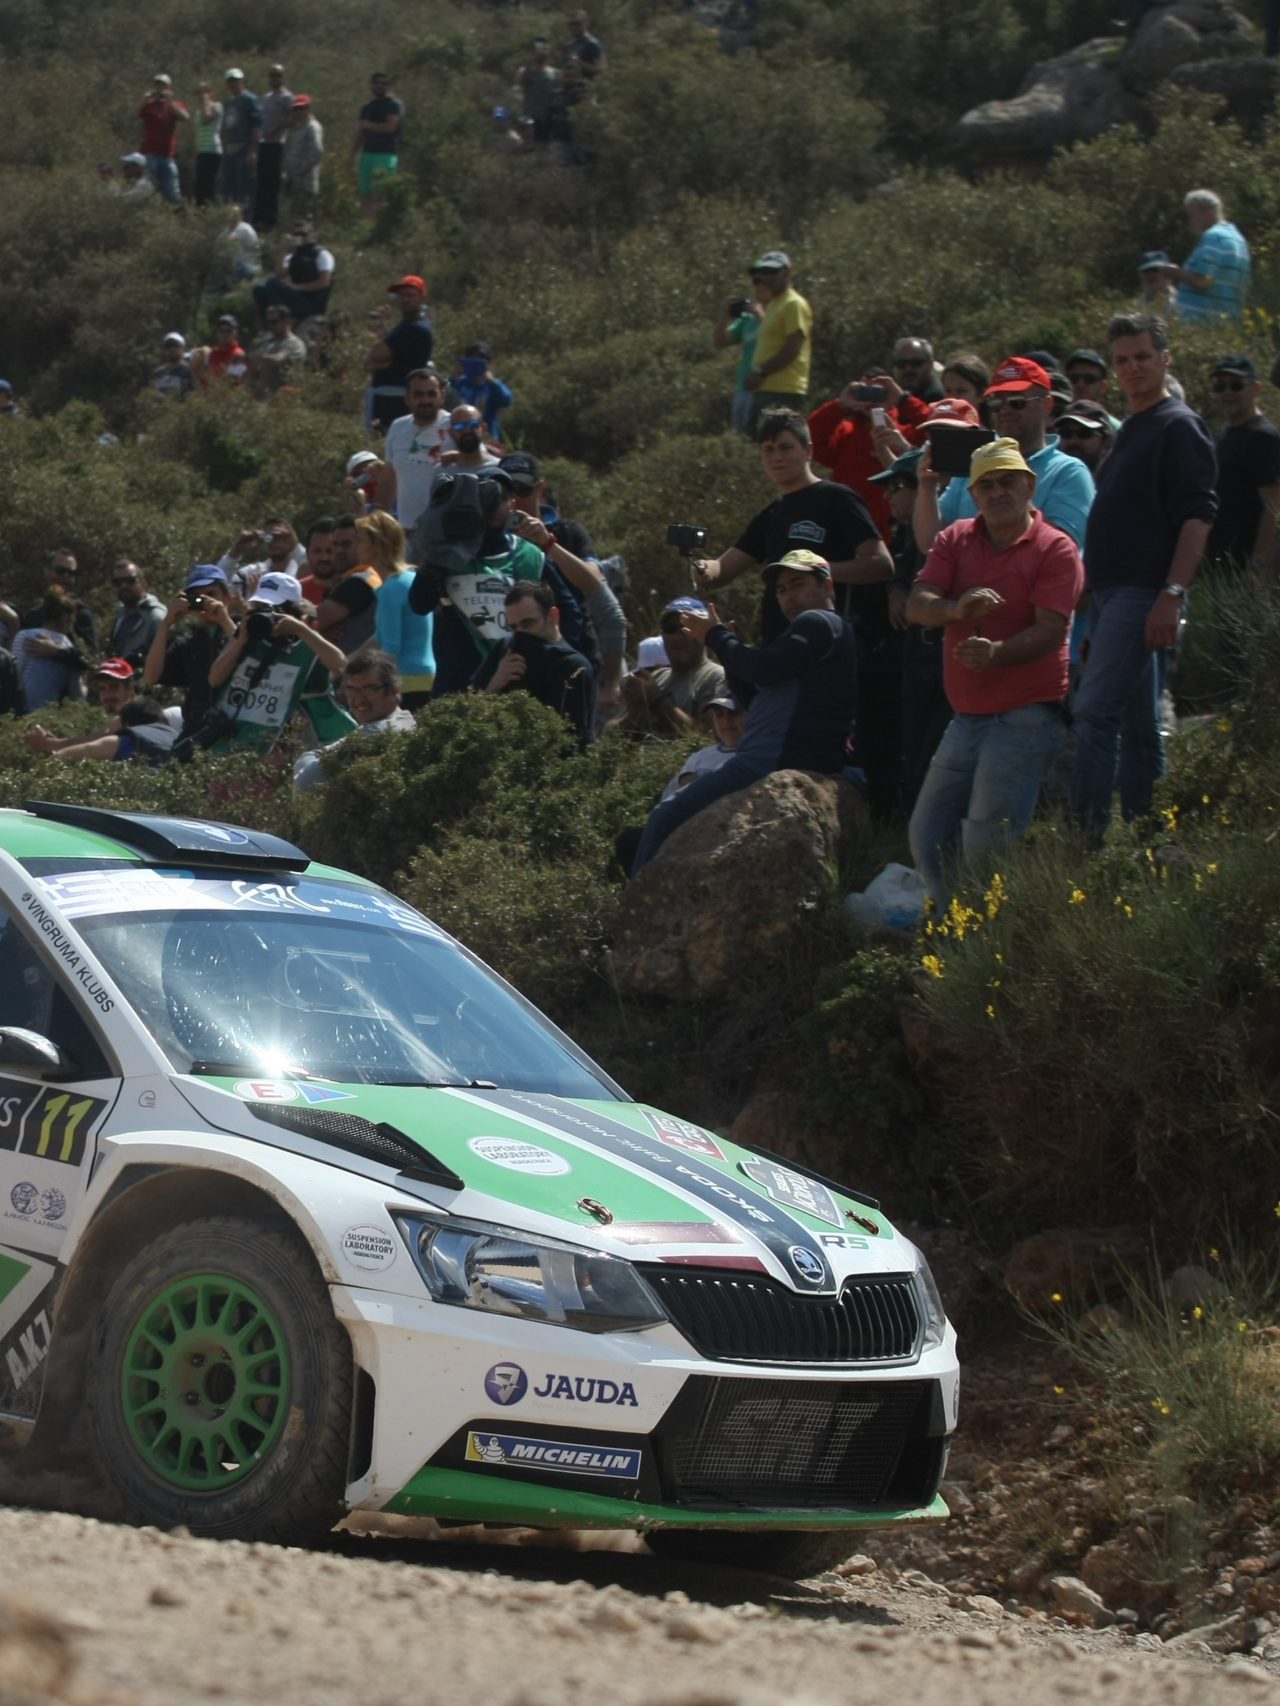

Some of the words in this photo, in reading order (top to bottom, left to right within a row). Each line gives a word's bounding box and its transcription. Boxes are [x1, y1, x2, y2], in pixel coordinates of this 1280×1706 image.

[245, 692, 278, 714] 098
[28, 898, 80, 968] VINGRUMA
[76, 967, 114, 1013] KLUBS
[251, 1083, 283, 1098] E
[36, 1094, 94, 1162] 11
[345, 1240, 393, 1254] LABORATORY
[347, 1233, 391, 1245] SUSPENSION
[534, 1374, 638, 1407] JAUDA
[511, 1444, 631, 1469] MICHELIN
